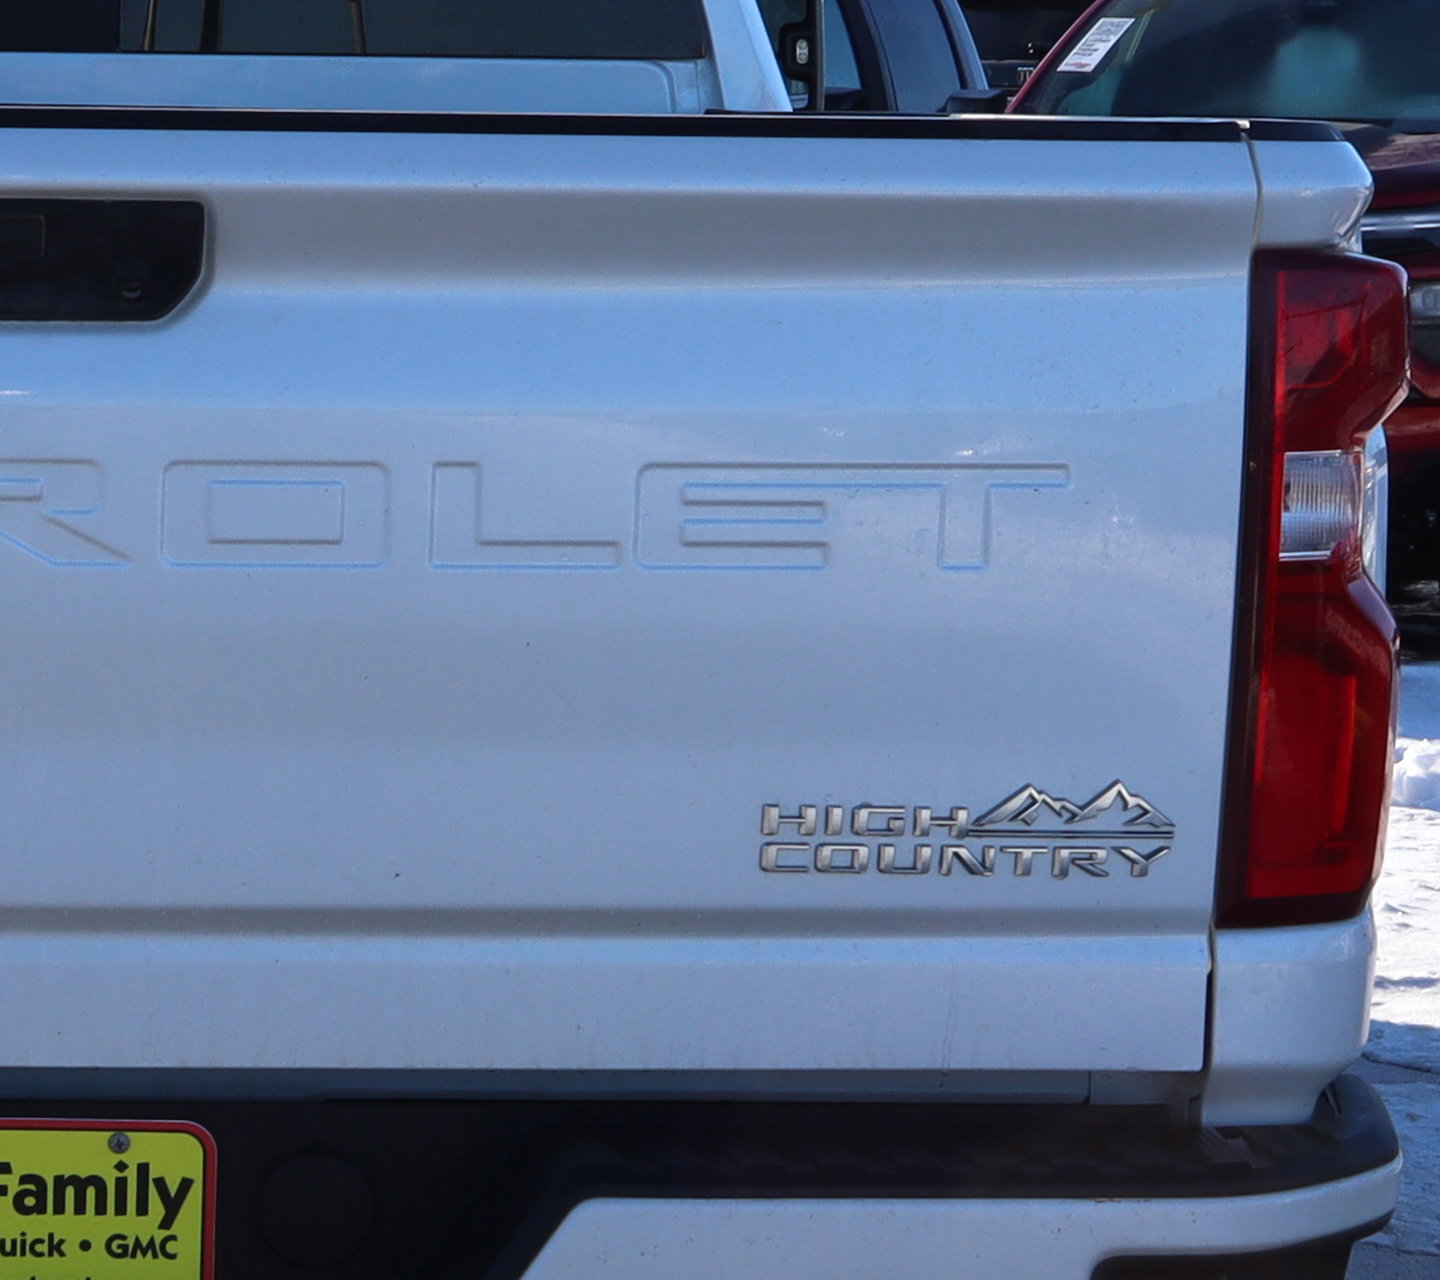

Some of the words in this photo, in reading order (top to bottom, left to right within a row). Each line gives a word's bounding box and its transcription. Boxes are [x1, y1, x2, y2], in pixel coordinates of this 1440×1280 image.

[760, 803, 969, 838] HIGH
[759, 842, 1172, 879] COUNTRY
[104, 1234, 178, 1260] GMC
